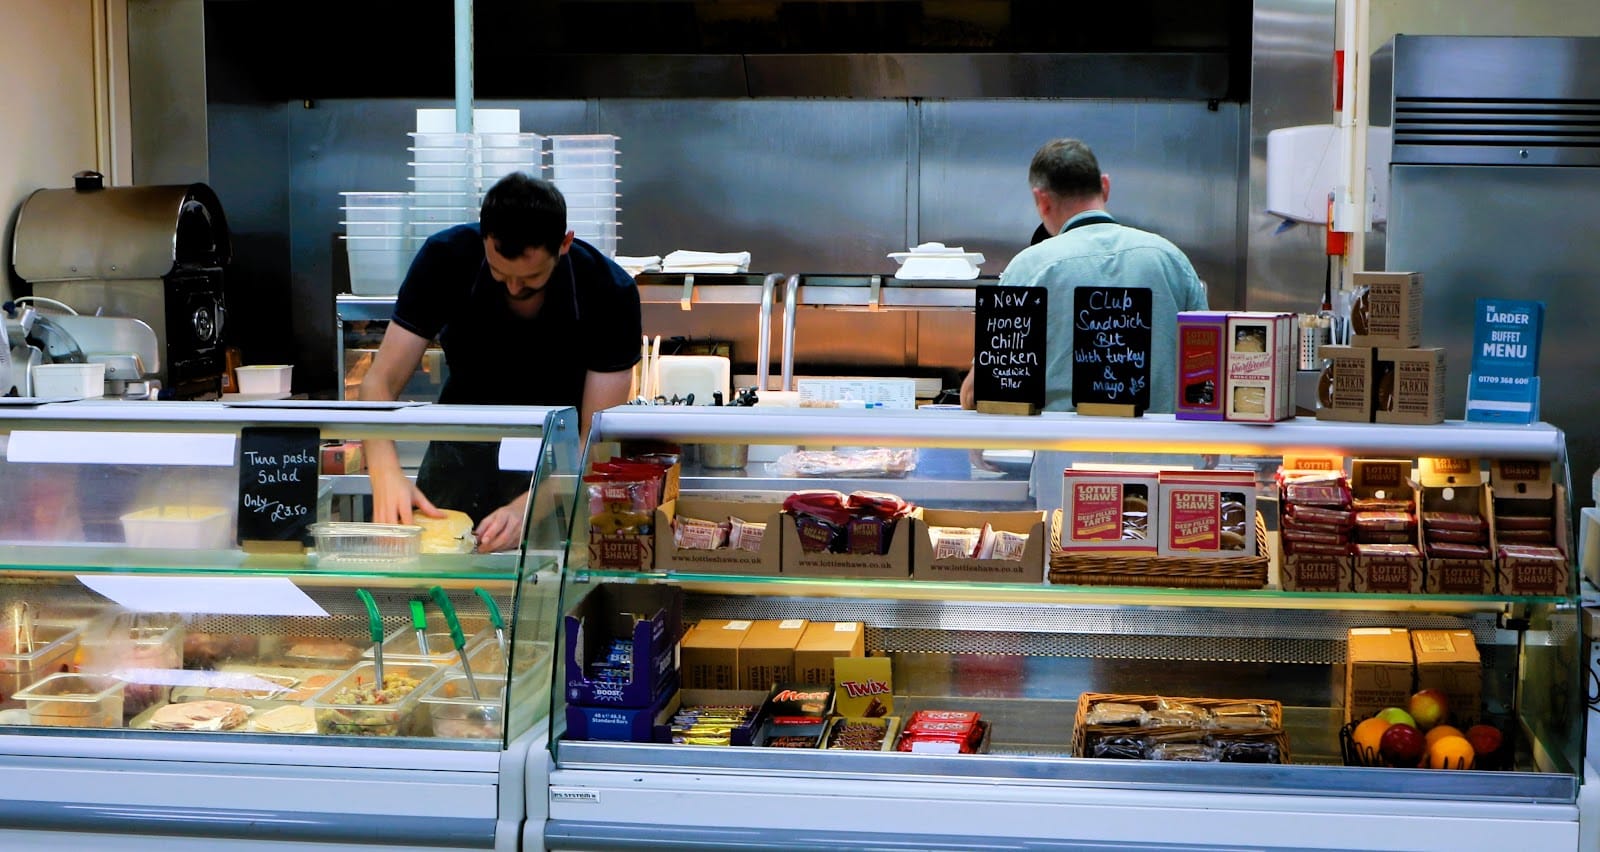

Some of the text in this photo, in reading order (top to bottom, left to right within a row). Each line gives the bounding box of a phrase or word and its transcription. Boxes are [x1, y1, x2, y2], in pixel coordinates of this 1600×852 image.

[1371, 303, 1400, 315] PARKIN
[1486, 313, 1529, 324] LARDER
[987, 316, 1032, 337] Honey
[991, 332, 1025, 349] Chilli
[1491, 331, 1521, 342] BUFFET
[1483, 343, 1528, 358] MENU
[979, 351, 1039, 366] Chicken
[1106, 347, 1145, 368] turkey
[1103, 367, 1117, 380] &
[1000, 378, 1023, 390] Filler
[1336, 376, 1364, 388] PARKIN
[1478, 375, 1499, 384] 01709
[1400, 380, 1429, 393] PARKIN
[243, 449, 317, 468] Tuna pasta
[1298, 461, 1331, 470] LOTTIE
[1365, 466, 1398, 474] LOTTIE
[257, 468, 301, 484] Salad
[1078, 486, 1118, 494] LOTTIE
[1174, 494, 1215, 502] LOTTIE
[271, 504, 308, 522] £3.50
[1095, 509, 1118, 518] FILLED
[1083, 516, 1112, 527] TARTS
[1193, 518, 1216, 527] FILLED
[1181, 525, 1210, 536] TARTS
[603, 543, 638, 551] LOTTIE
[671, 555, 762, 564] www.lottieshaws.co.uk
[799, 559, 892, 569] www.lottieshaws.co.uk
[930, 564, 1023, 573] www.lottieshaws.co.uk
[1301, 563, 1336, 571] LOTTIE
[1371, 566, 1407, 574] LOTTIE
[1445, 568, 1480, 576] LOTTIE
[1518, 567, 1553, 575] LOTTIE
[841, 679, 892, 698] Twix
[773, 689, 830, 702] Mars
